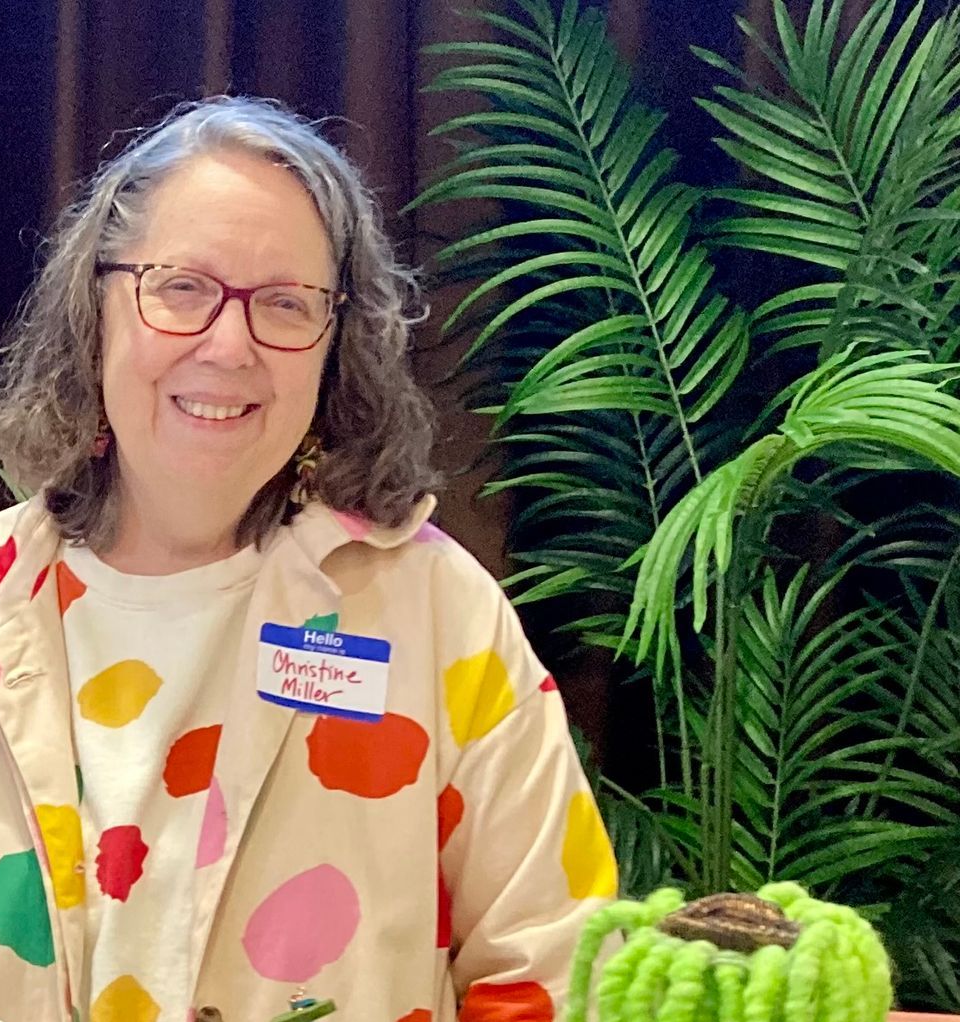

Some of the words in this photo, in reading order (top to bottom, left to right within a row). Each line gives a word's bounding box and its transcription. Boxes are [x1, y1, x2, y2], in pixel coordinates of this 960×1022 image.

[304, 630, 344, 647] Hello
[272, 649, 362, 684] Christine
[281, 678, 343, 702] Miller
